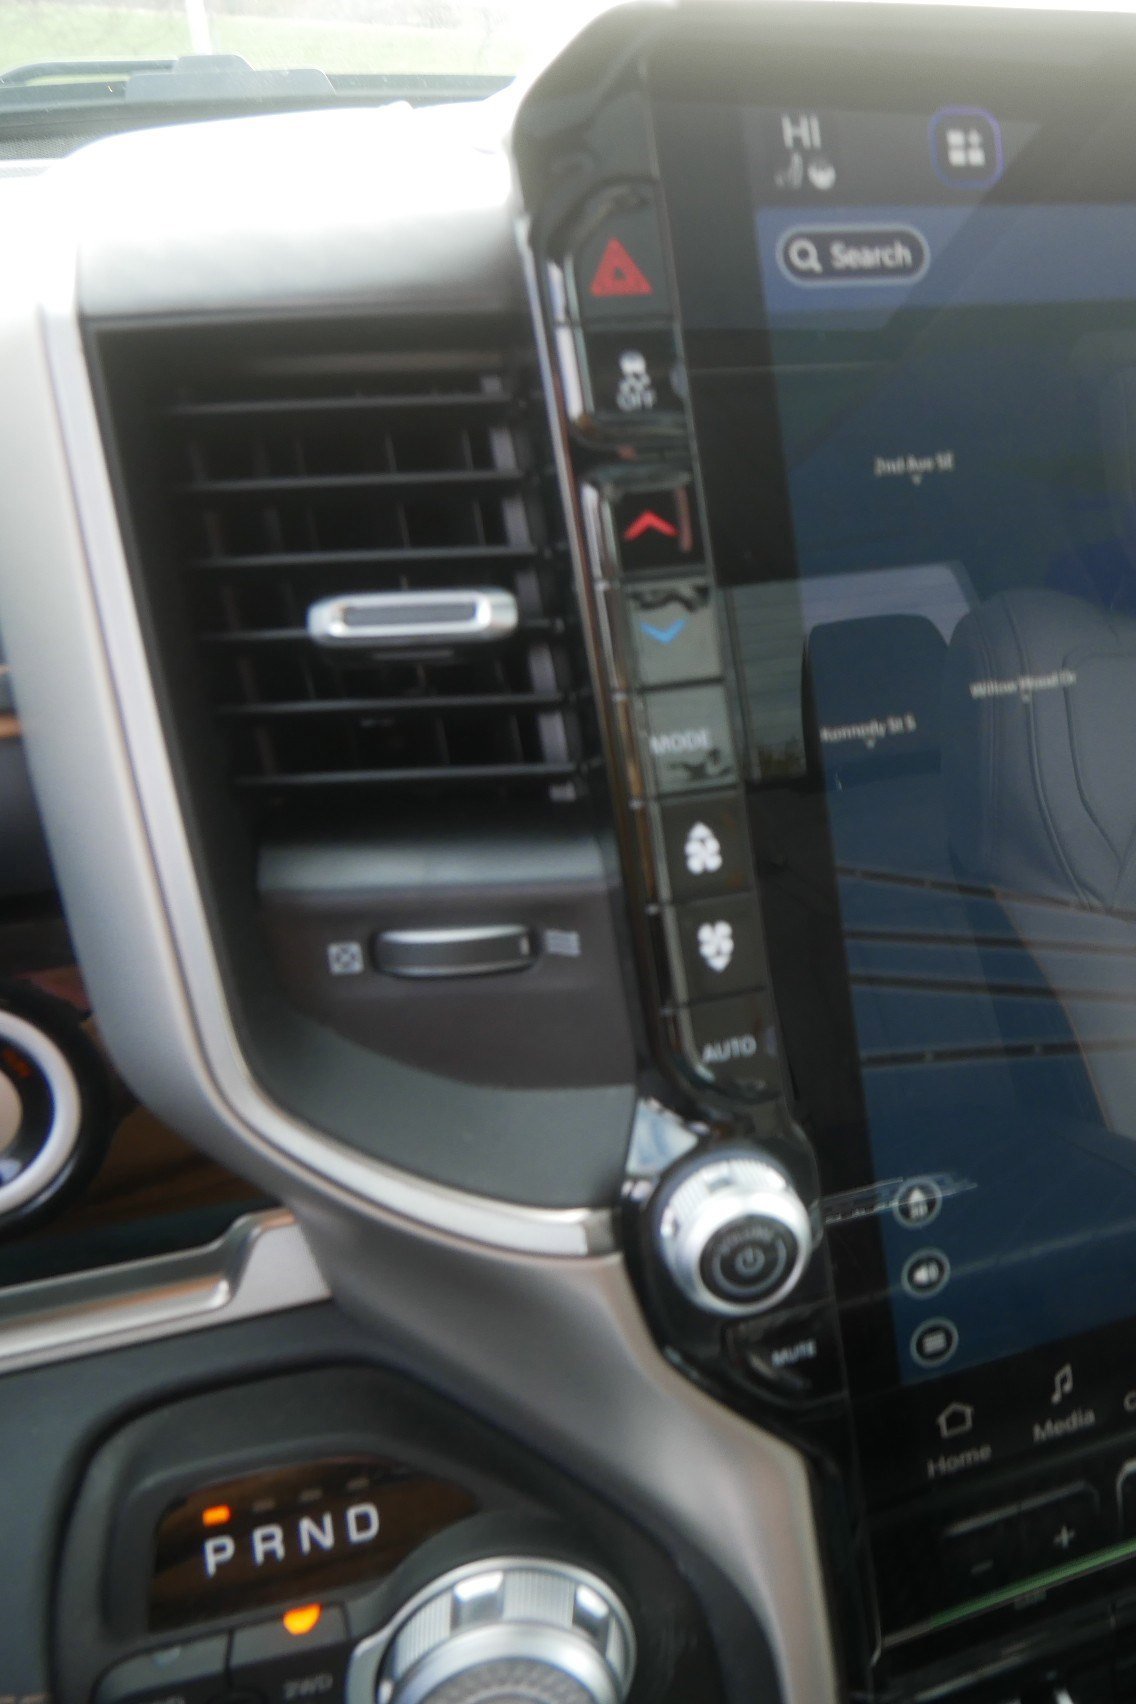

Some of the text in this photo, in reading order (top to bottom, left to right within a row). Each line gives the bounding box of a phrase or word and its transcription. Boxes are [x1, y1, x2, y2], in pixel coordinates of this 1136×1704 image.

[781, 112, 822, 150] HI
[829, 240, 913, 270] Search
[702, 1033, 758, 1064] AUTO
[770, 1338, 817, 1368] MUTE
[1032, 1408, 1096, 1443] Media
[926, 1444, 993, 1480] Home
